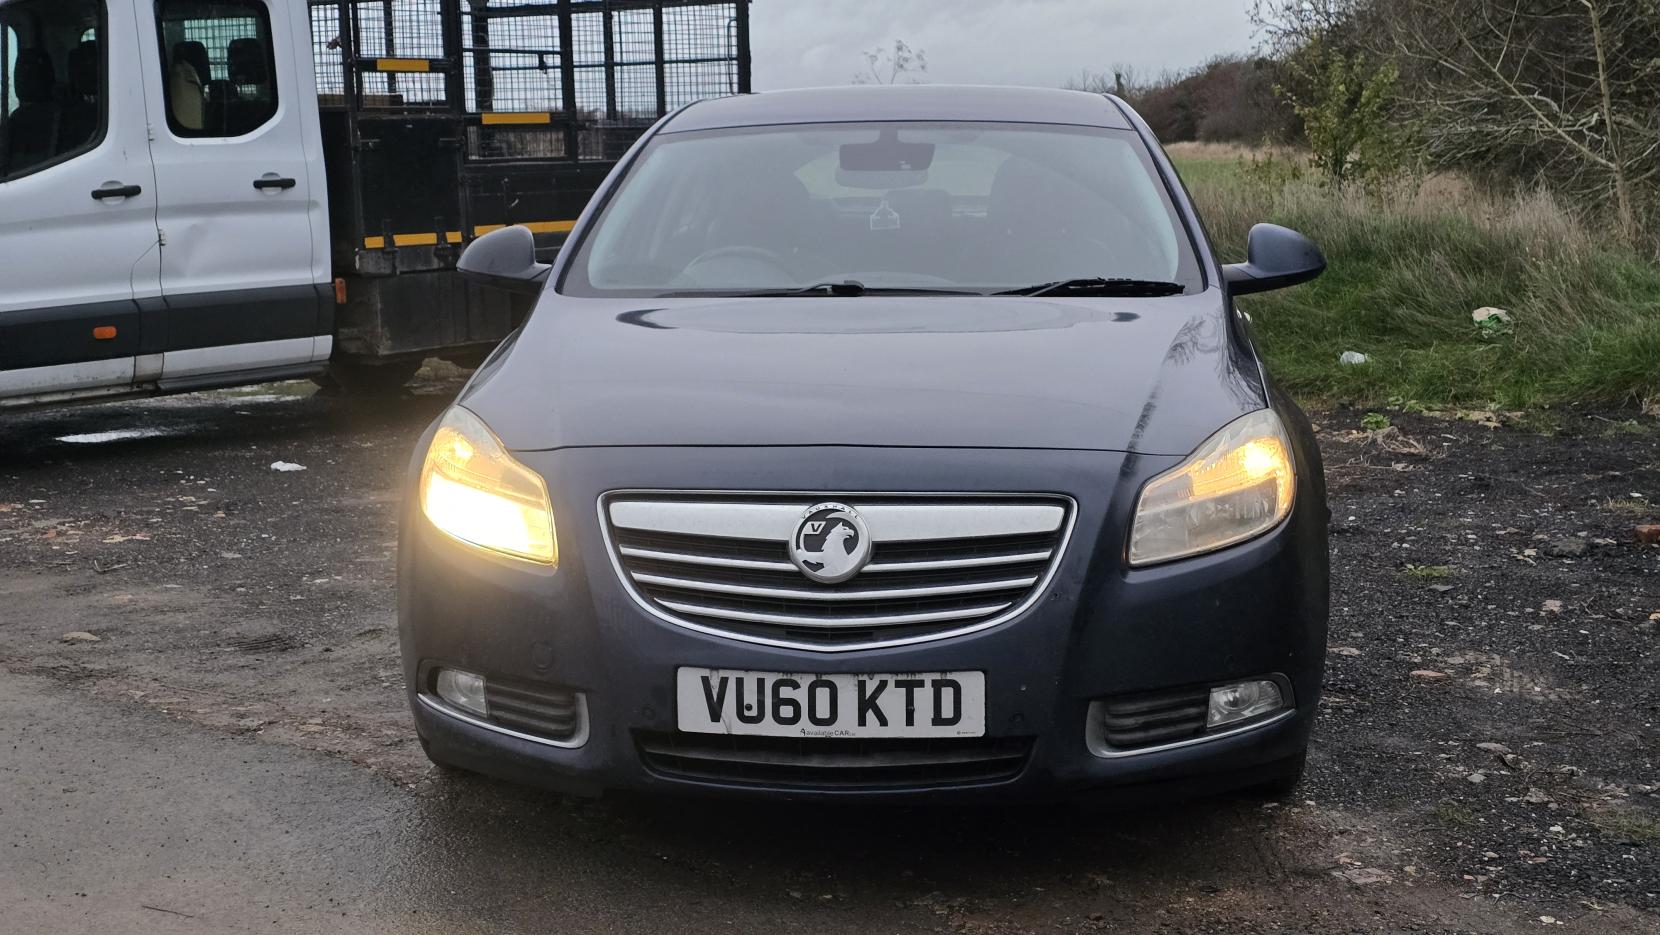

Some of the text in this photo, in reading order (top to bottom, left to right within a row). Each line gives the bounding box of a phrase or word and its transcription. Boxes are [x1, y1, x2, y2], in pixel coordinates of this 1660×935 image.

[811, 523, 822, 532] V
[700, 675, 962, 727] VU60 KTD
